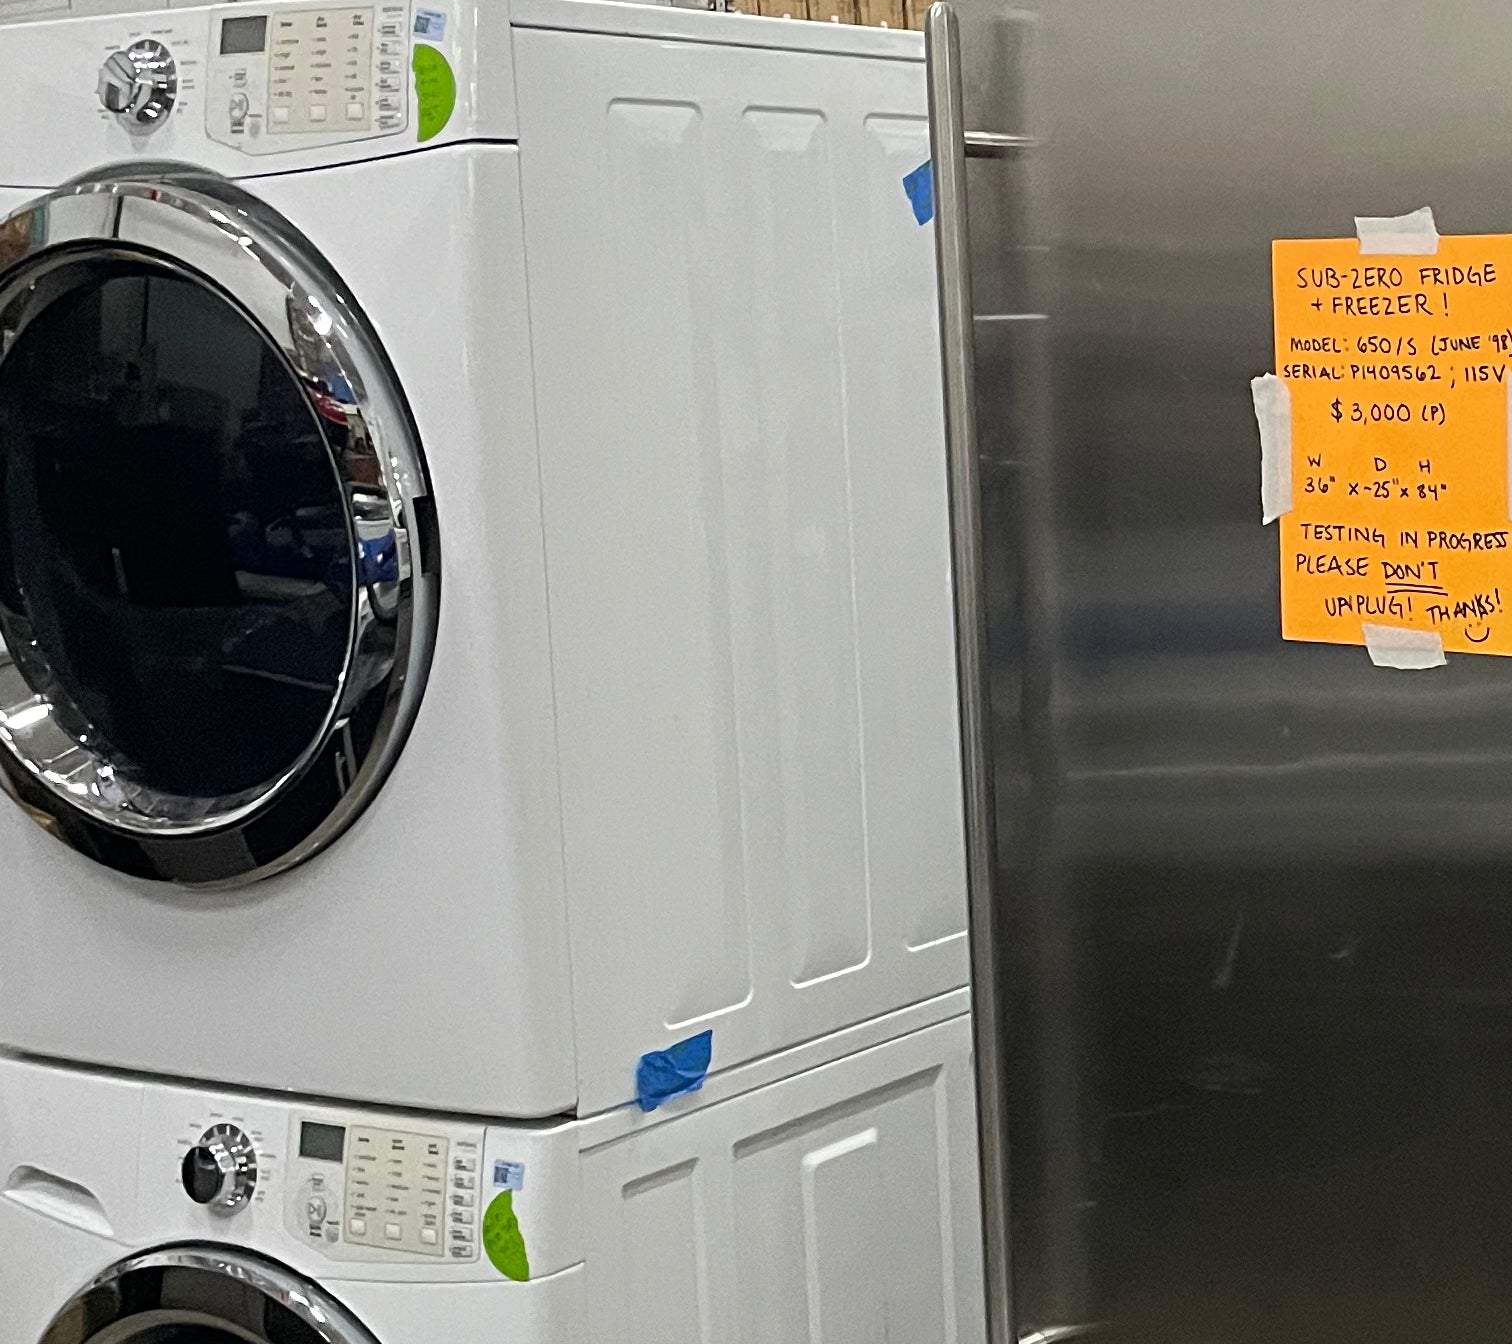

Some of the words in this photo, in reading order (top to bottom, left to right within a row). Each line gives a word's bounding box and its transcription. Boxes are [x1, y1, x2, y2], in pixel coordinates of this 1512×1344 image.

[1296, 267, 1403, 290] SUB-ZERO
[1418, 263, 1498, 287] FRIDGE
[1310, 297, 1324, 312] +
[1290, 336, 1349, 354] MODEL:
[1431, 335, 1482, 356] (JUNE
[1283, 363, 1346, 381] SERIAL:
[1464, 363, 1507, 384] 115V
[1421, 402, 1447, 426] (P)
[1307, 452, 1322, 468] W
[1373, 457, 1388, 472] D
[1418, 458, 1431, 475] H
[1304, 475, 1336, 494] 36"
[1416, 483, 1447, 502] 84"
[1300, 523, 1386, 549] TESTING
[1400, 530, 1419, 549] IN
[1296, 553, 1370, 577] PLEASE
[1381, 561, 1440, 580] DON'T
[1324, 594, 1415, 622] UNPLUG!
[1426, 588, 1504, 626] THANKS!
